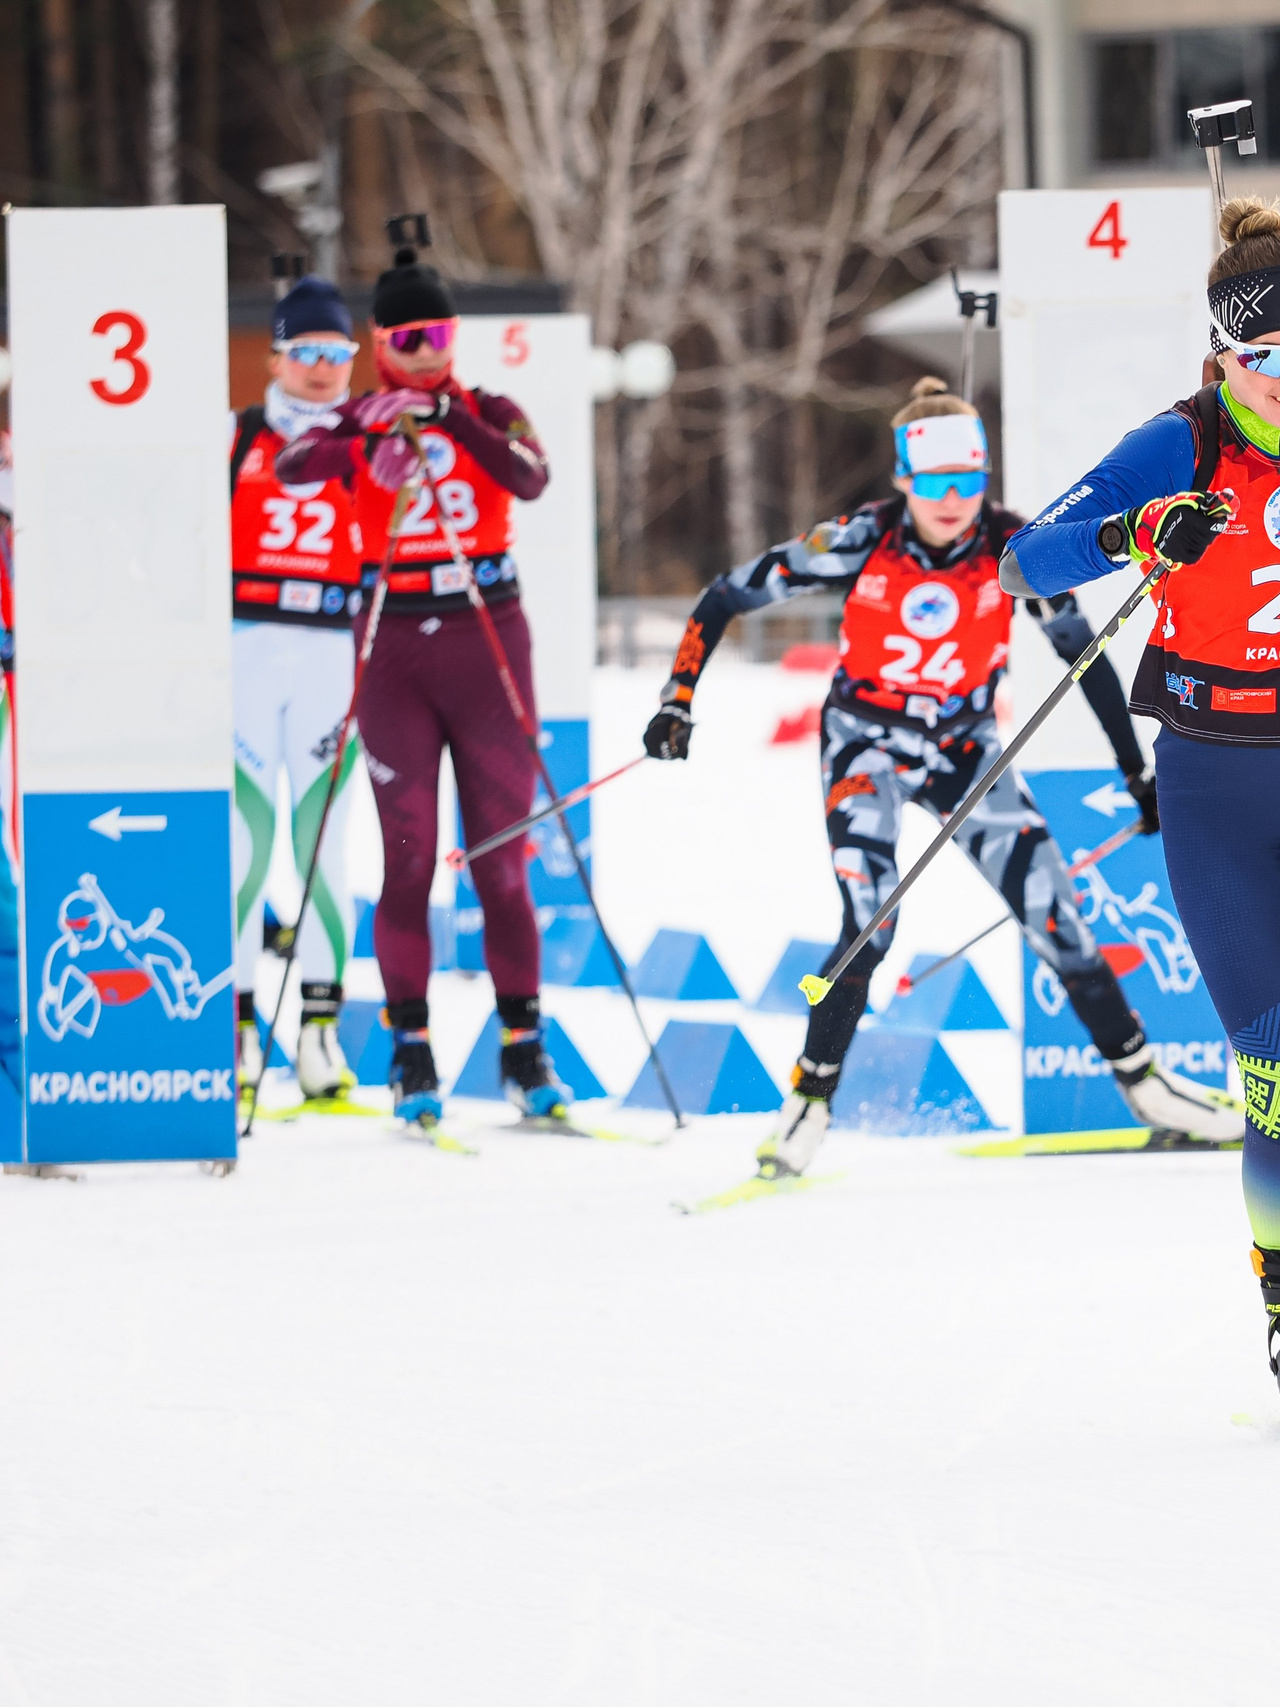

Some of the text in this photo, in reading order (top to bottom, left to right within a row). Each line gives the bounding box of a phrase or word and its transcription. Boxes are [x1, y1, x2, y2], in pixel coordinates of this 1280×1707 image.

[1087, 200, 1128, 259] 4
[88, 310, 152, 406] 3
[501, 325, 530, 367] 5
[259, 498, 336, 554] 32
[397, 479, 479, 537] 28
[879, 634, 966, 687] 24
[30, 1068, 234, 1105] КРАСНОЯРСК
[1025, 1041, 1224, 1078] КРАСРСК
